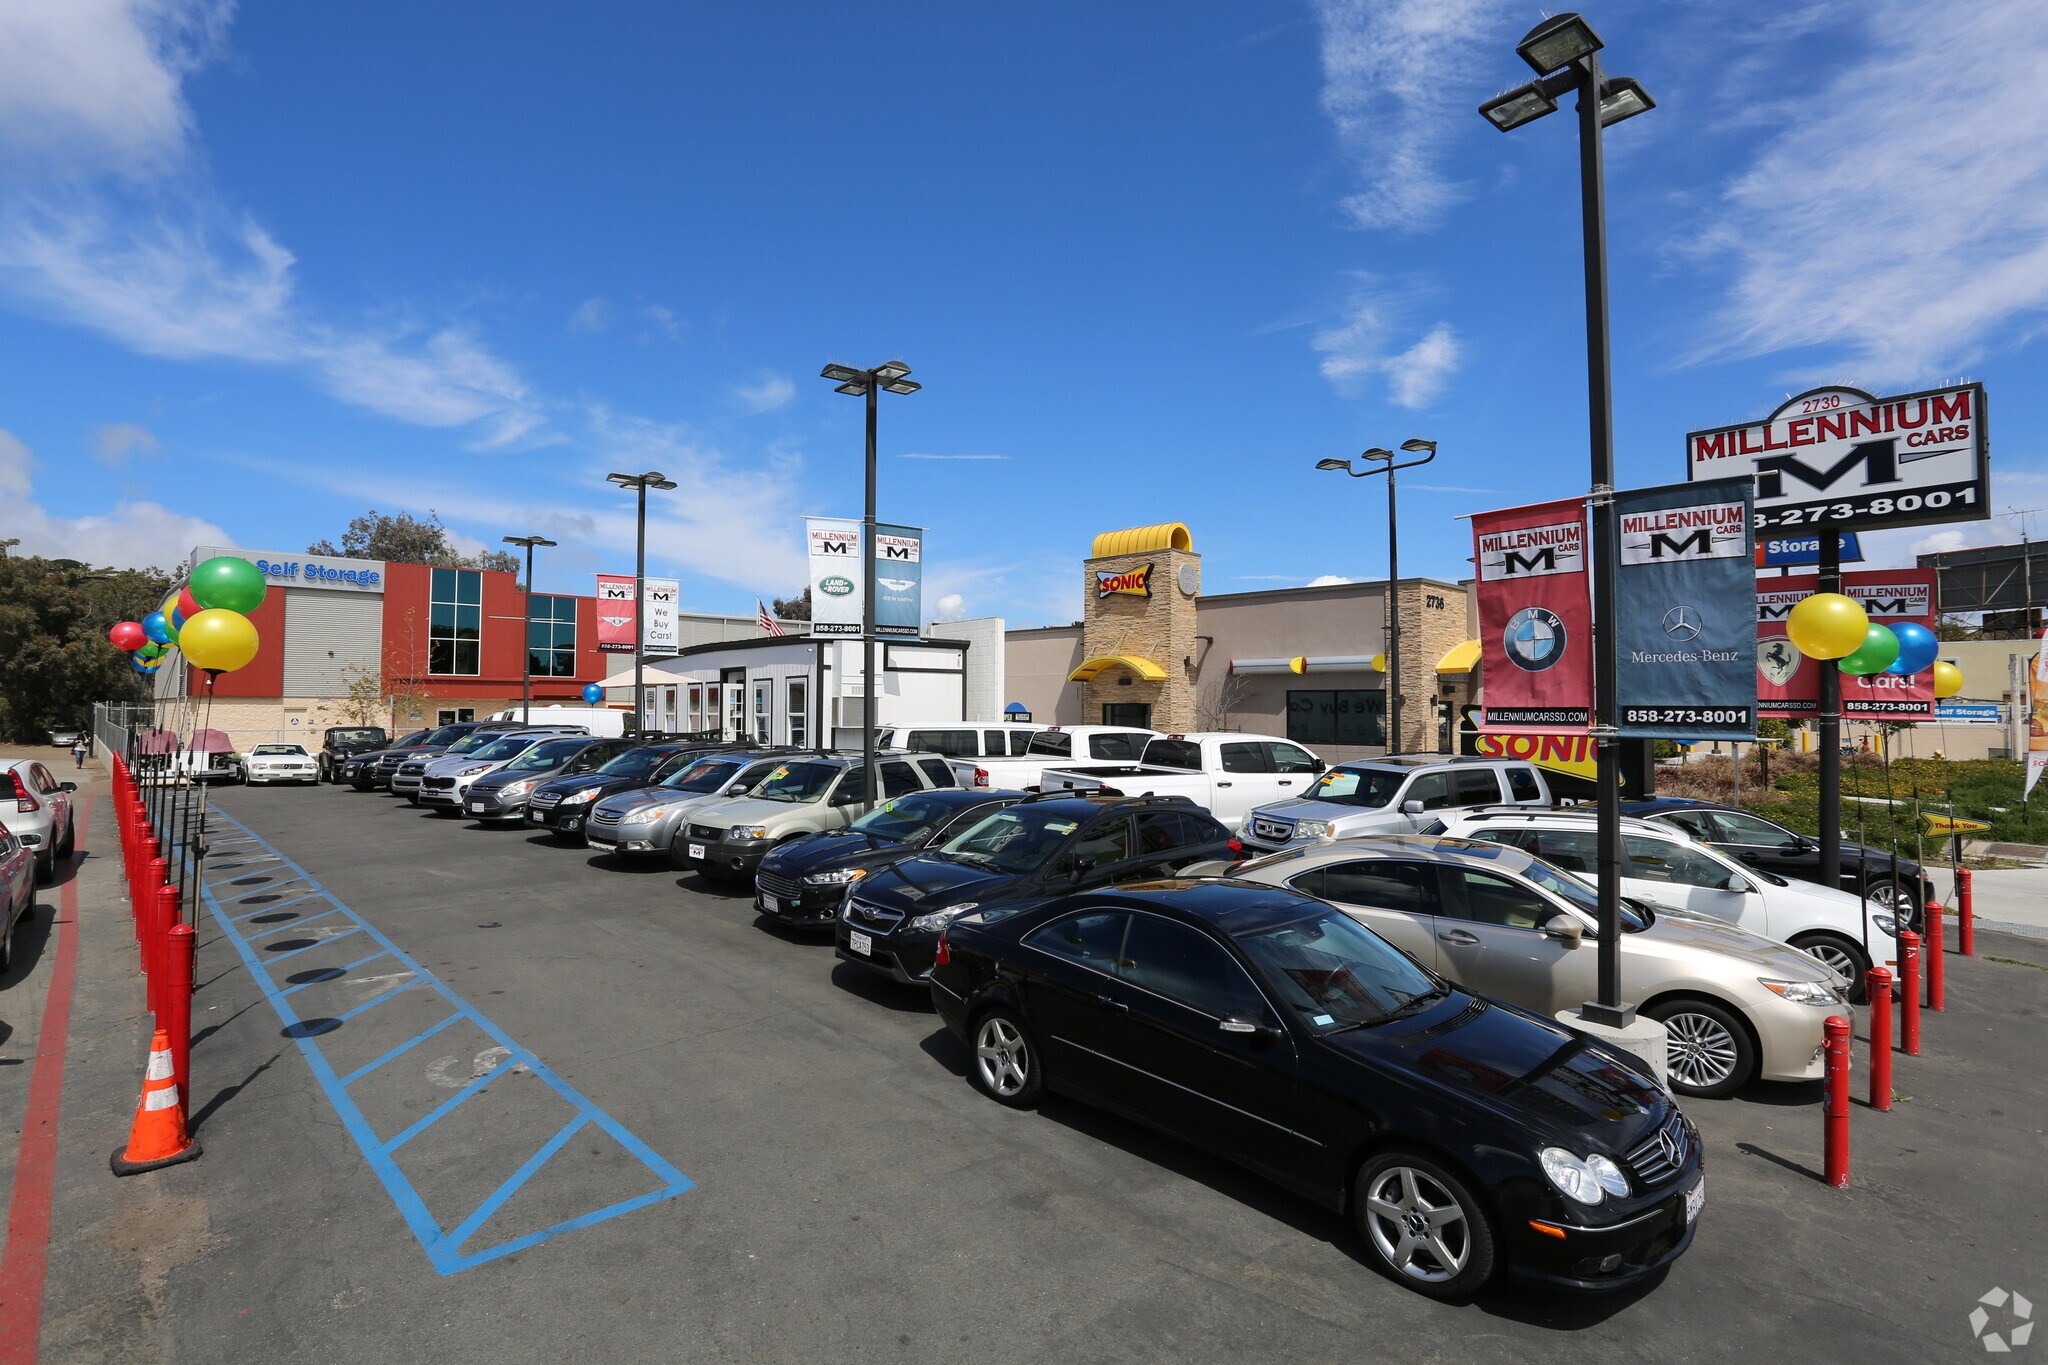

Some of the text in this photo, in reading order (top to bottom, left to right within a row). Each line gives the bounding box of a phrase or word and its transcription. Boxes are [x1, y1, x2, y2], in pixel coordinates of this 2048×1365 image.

[1802, 394, 1840, 413] 2730
[1696, 391, 1972, 462] MILLENNIUM
[1907, 424, 1970, 448] CARS
[1623, 506, 1743, 534] MILLENNIUM
[1716, 524, 1742, 535] CARS
[811, 532, 857, 542] MILLENNIUM
[877, 537, 919, 548] MILLENNIUM
[1482, 527, 1580, 553] MILLENNIUM
[1649, 529, 1713, 558] M
[823, 541, 847, 554] M
[1558, 543, 1579, 552] CARS
[1768, 538, 1846, 553] Storae
[887, 546, 909, 559] M
[1503, 547, 1557, 574] M
[256, 559, 380, 585] Self Storage
[1102, 573, 1144, 592] SONIC
[1847, 587, 1927, 598] MILLENNIUM
[655, 608, 668, 616] We
[1864, 598, 1908, 613] M
[654, 620, 669, 629] Buy
[1510, 610, 1560, 630] BMW
[650, 631, 672, 640] Cars!
[1631, 650, 1738, 663] Mercedes-Benz
[1847, 702, 1928, 711] 858-273-8001
[1956, 708, 1996, 716] Storage
[1487, 712, 1588, 722] MILLENNIUMCARSSD.COM
[1627, 710, 1746, 724] 858-273-8001
[1482, 735, 1597, 762] SONI
